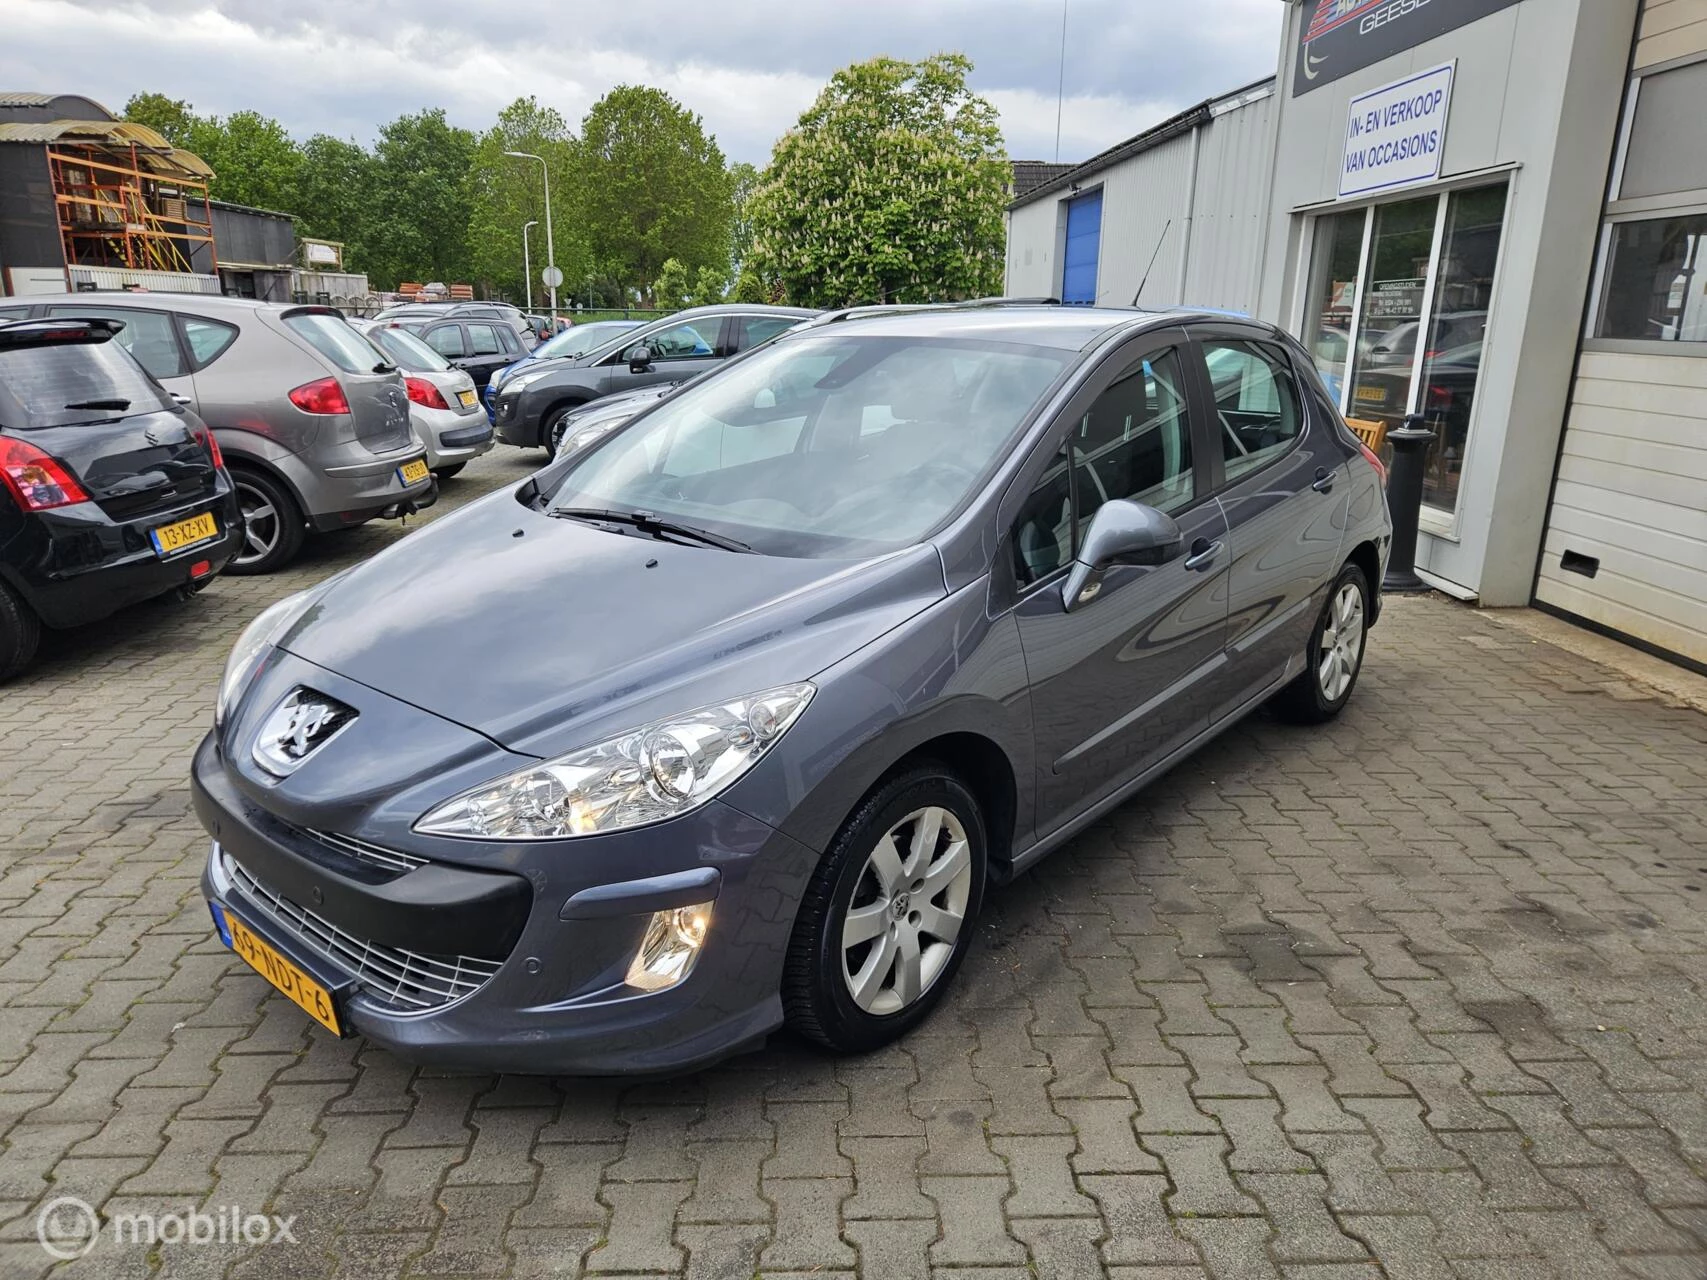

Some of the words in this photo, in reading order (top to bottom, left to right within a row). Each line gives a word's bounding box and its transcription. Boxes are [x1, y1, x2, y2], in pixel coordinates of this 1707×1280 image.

[1349, 116, 1363, 139] IN-
[1365, 108, 1381, 134] EN
[1384, 89, 1442, 128] VERKOOP
[1346, 149, 1366, 174] VAN
[1367, 129, 1438, 168] OCCASIONS
[163, 517, 209, 547] 13-XZ-XV
[232, 922, 330, 1022] 69-NDT-6
